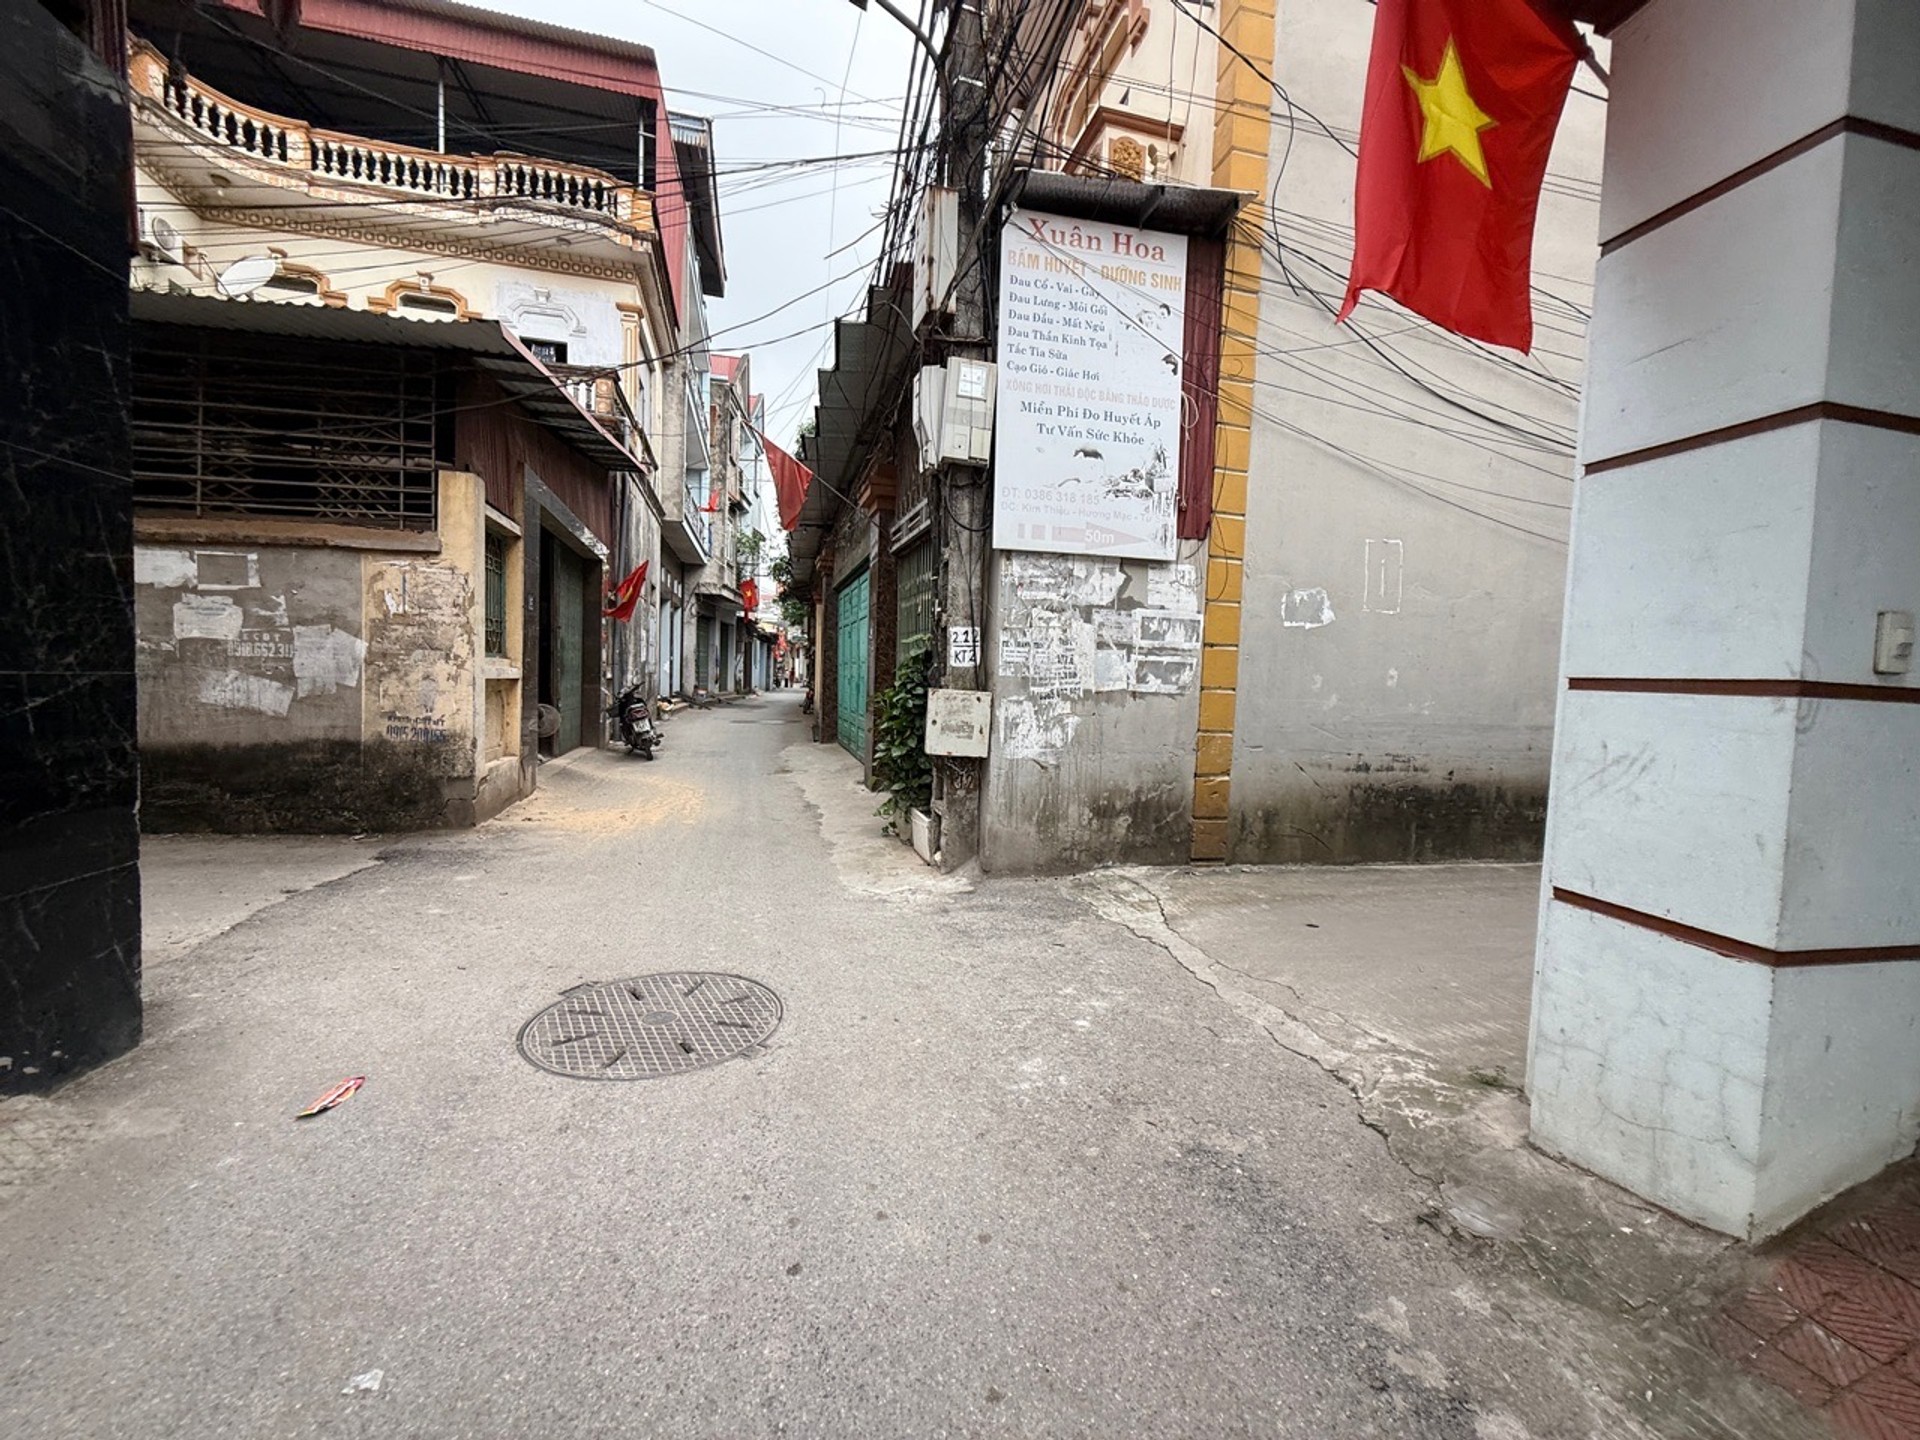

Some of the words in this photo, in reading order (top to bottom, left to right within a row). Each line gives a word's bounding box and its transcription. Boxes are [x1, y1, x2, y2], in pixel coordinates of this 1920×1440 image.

[1028, 217, 1103, 252] Xuân
[1112, 231, 1166, 262] Hoa
[1007, 247, 1040, 271] BẤM
[1151, 273, 1182, 292] SINH
[1056, 282, 1072, 294] Vai
[1009, 291, 1031, 305] Đau
[1033, 295, 1060, 310] Lưng
[1068, 301, 1088, 313] Mỏi
[1008, 309, 1030, 321] Đau
[1084, 320, 1105, 333] Ngủ
[1007, 326, 1029, 339] Đau
[1062, 333, 1086, 346] Kinh
[1089, 337, 1108, 350] Tọa
[1029, 346, 1045, 358] Tia
[1006, 360, 1027, 373] Cạo
[1029, 363, 1048, 375] Gió
[1056, 366, 1080, 379] Giác
[1082, 370, 1100, 381] Hơi
[1006, 379, 1033, 393] XÔNG
[1057, 404, 1078, 418] Phí
[1082, 408, 1100, 421] Đo
[1103, 410, 1141, 426] Huyết
[1144, 413, 1161, 429] Áp
[1036, 422, 1055, 436] Tư
[1058, 424, 1083, 438] Vấn
[1086, 428, 1109, 441] Sức
[1113, 430, 1144, 445] Khỏe
[1024, 488, 1052, 501] 0386
[1021, 503, 1041, 513] Kim
[1085, 529, 1114, 544] 50m
